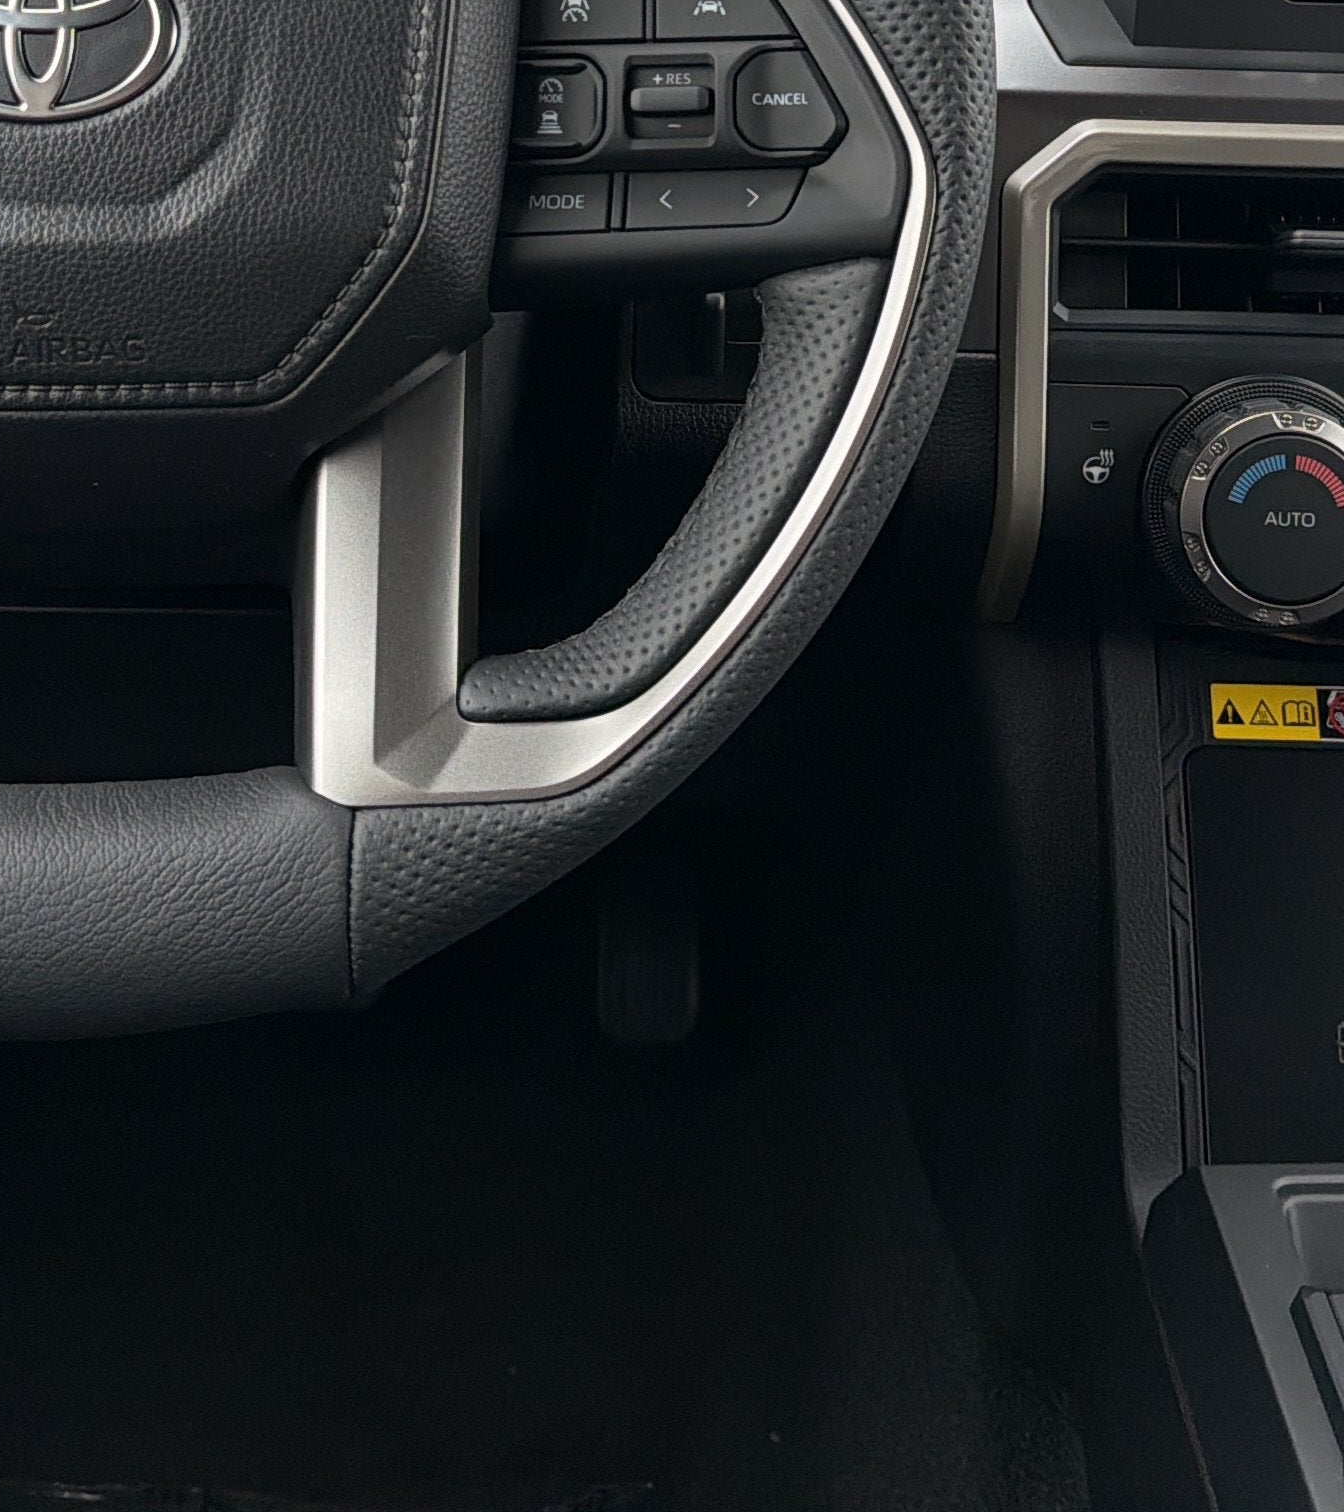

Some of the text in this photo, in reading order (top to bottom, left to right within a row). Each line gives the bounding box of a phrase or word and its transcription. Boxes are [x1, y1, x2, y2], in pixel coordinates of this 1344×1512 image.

[539, 94, 564, 104] MODE
[752, 92, 808, 106] CANCEL
[529, 194, 585, 210] MODE
[6, 338, 149, 366] AIRBAG
[1264, 511, 1316, 528] AUTO
